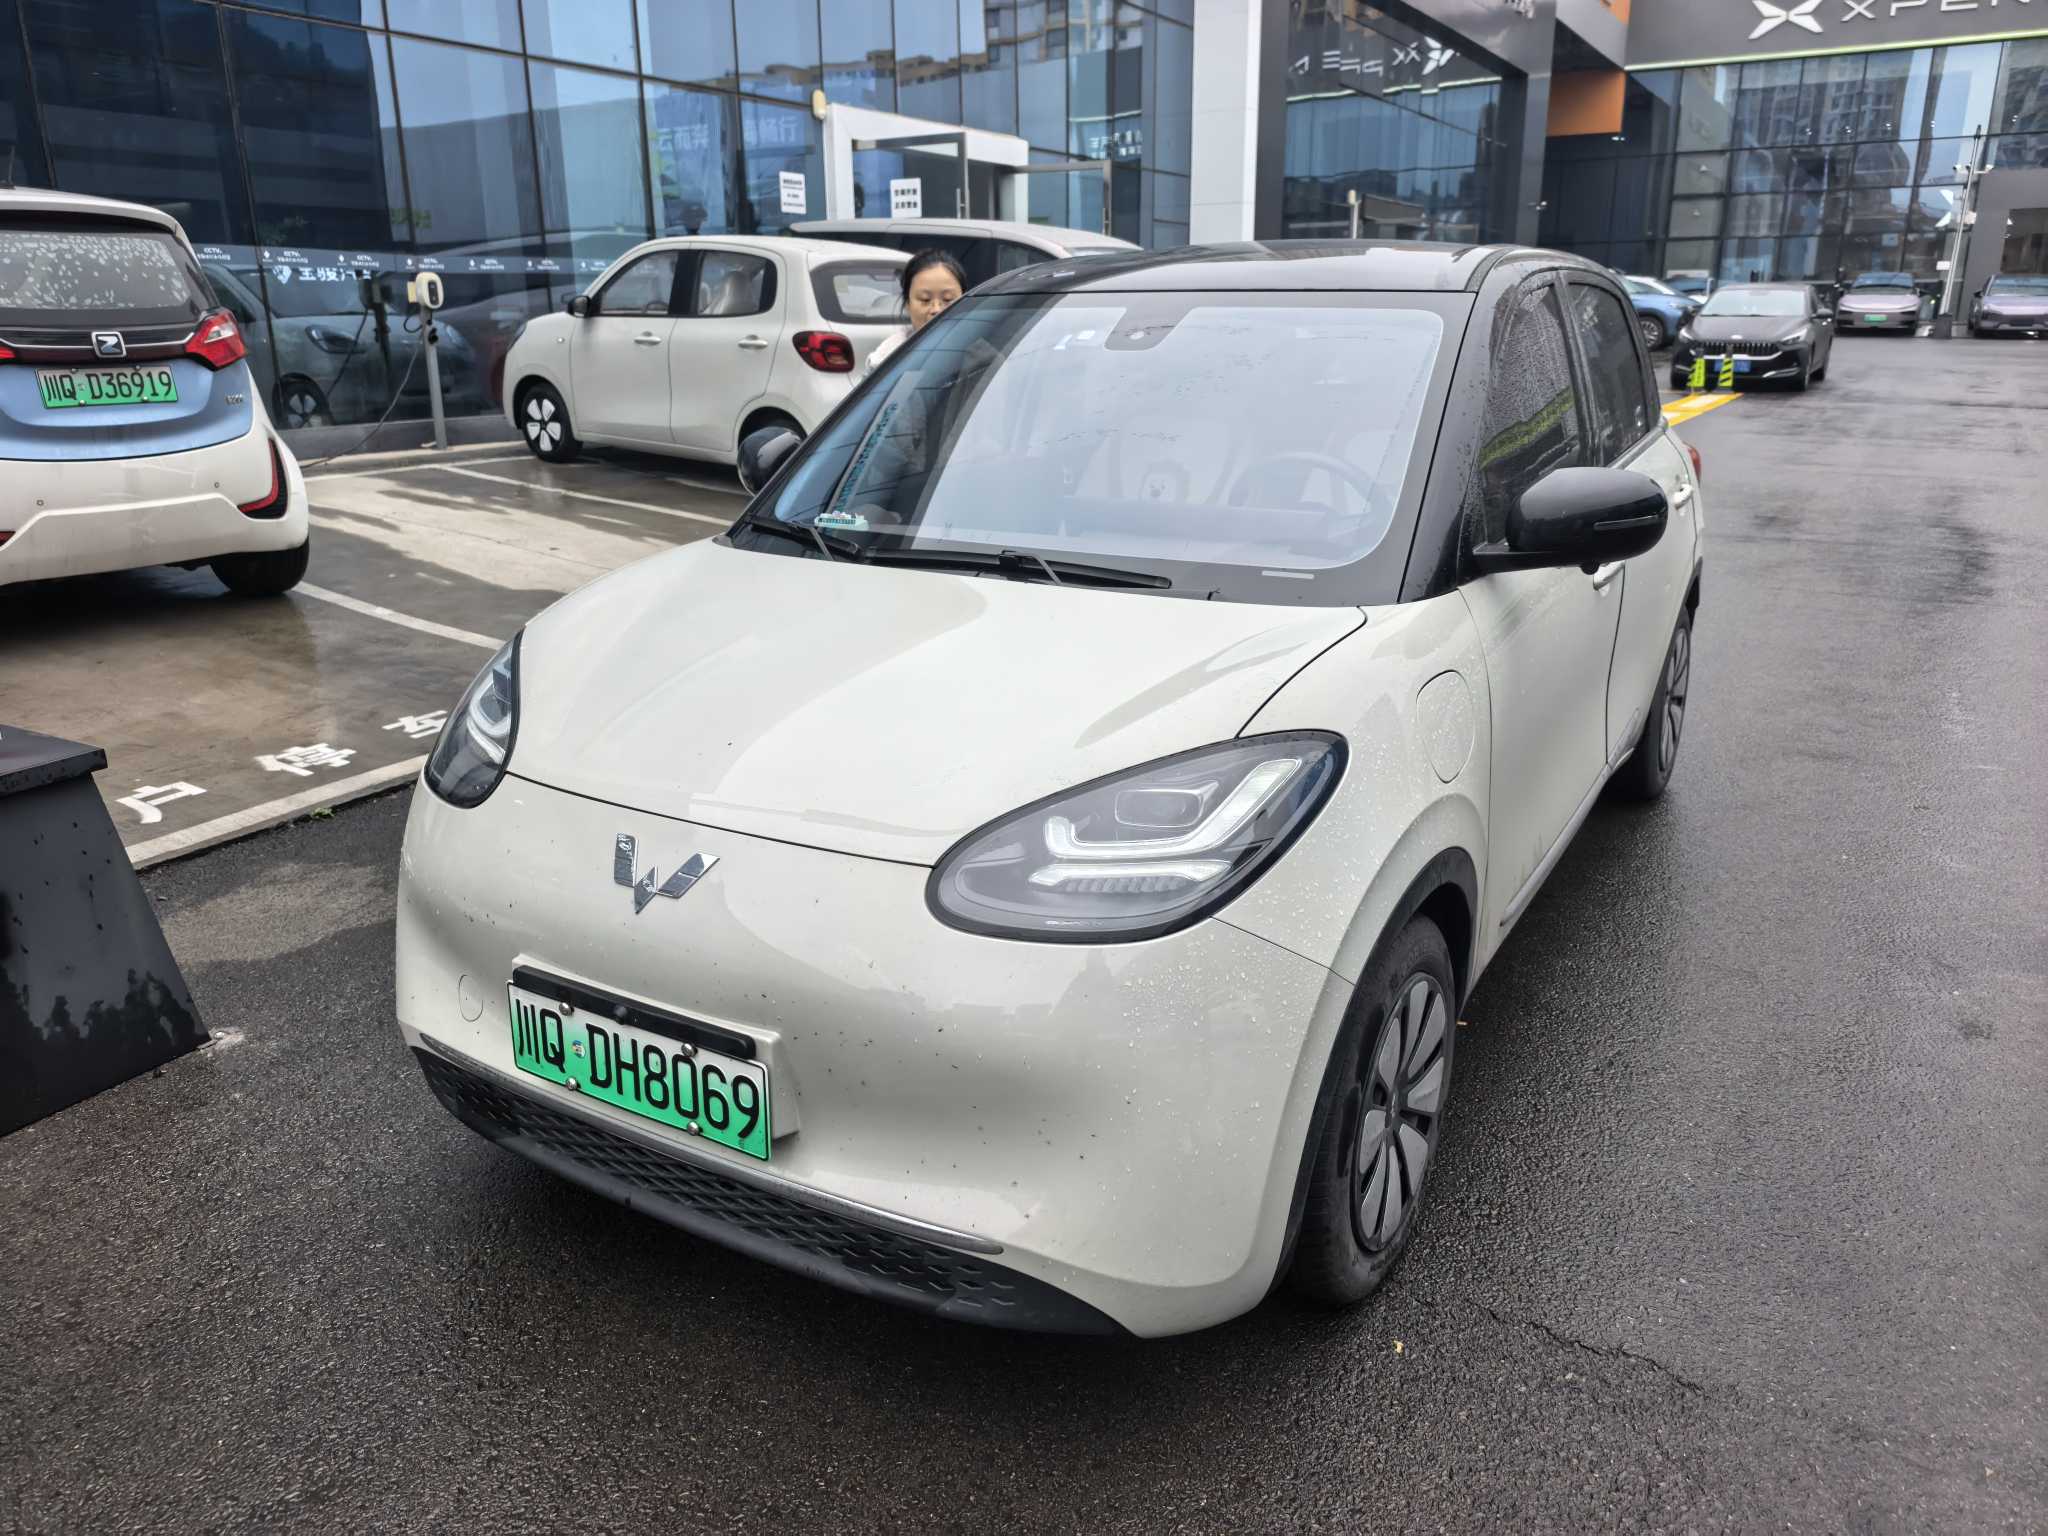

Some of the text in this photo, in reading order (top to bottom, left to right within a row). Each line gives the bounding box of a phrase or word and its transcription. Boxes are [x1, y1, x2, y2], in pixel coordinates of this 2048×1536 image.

[85, 370, 172, 399] D36919
[515, 999, 760, 1139] 川Q DH8069
